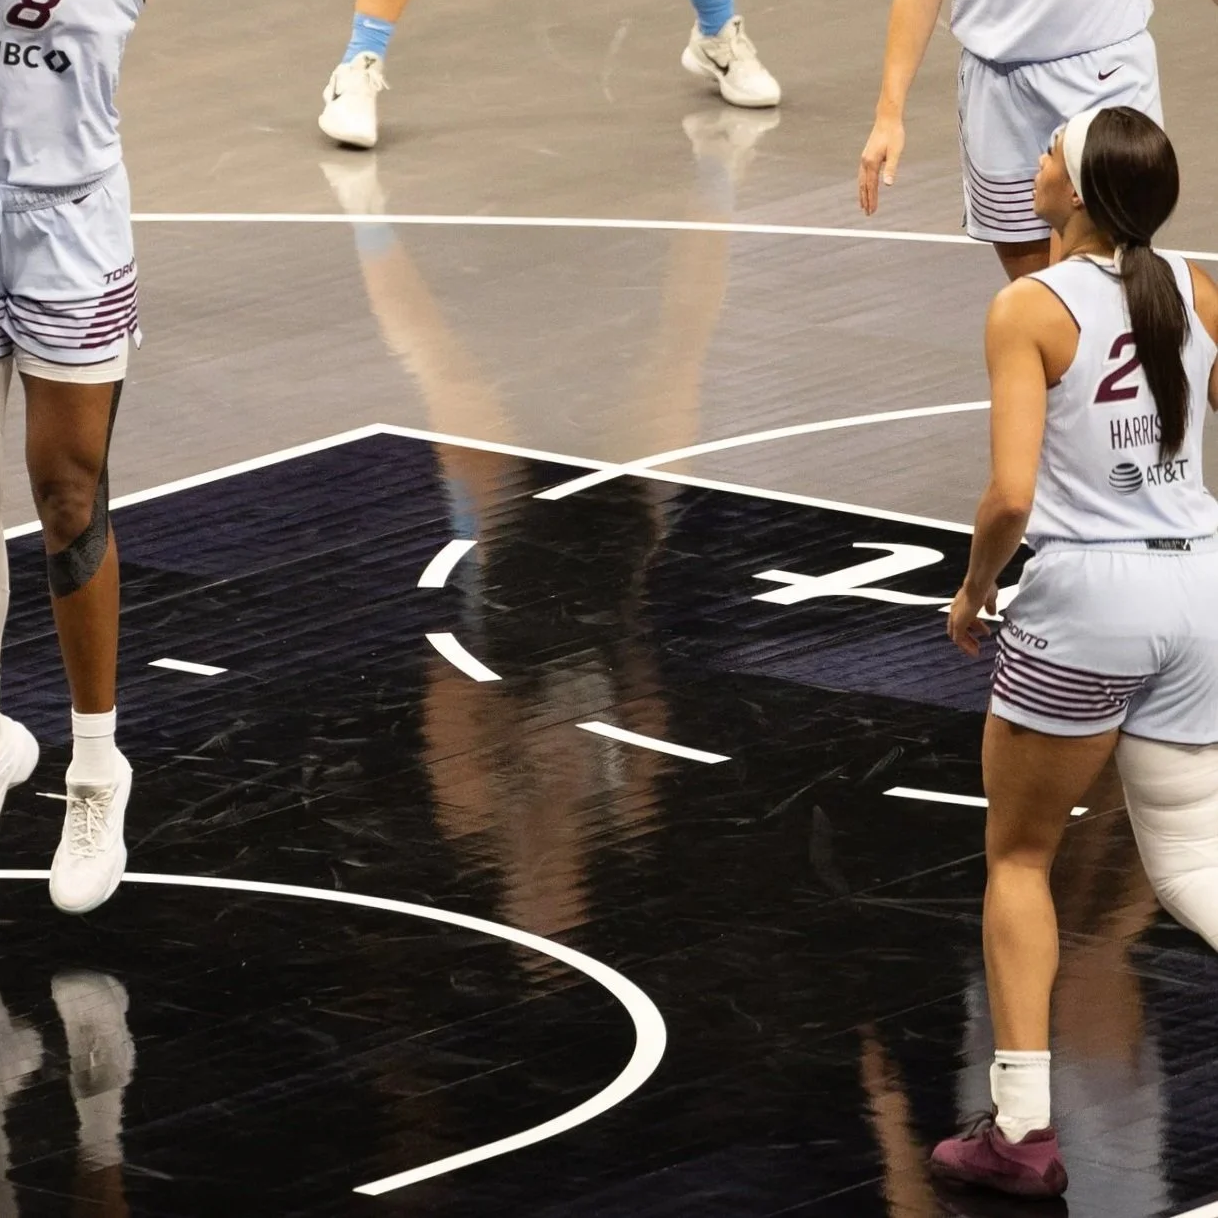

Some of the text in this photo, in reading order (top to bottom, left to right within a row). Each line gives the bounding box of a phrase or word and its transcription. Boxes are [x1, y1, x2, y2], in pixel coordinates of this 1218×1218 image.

[1094, 331, 1142, 404] 2
[1110, 413, 1163, 450] HARRIS
[1146, 459, 1189, 487] AT&T
[1005, 621, 1049, 650] RONTO
